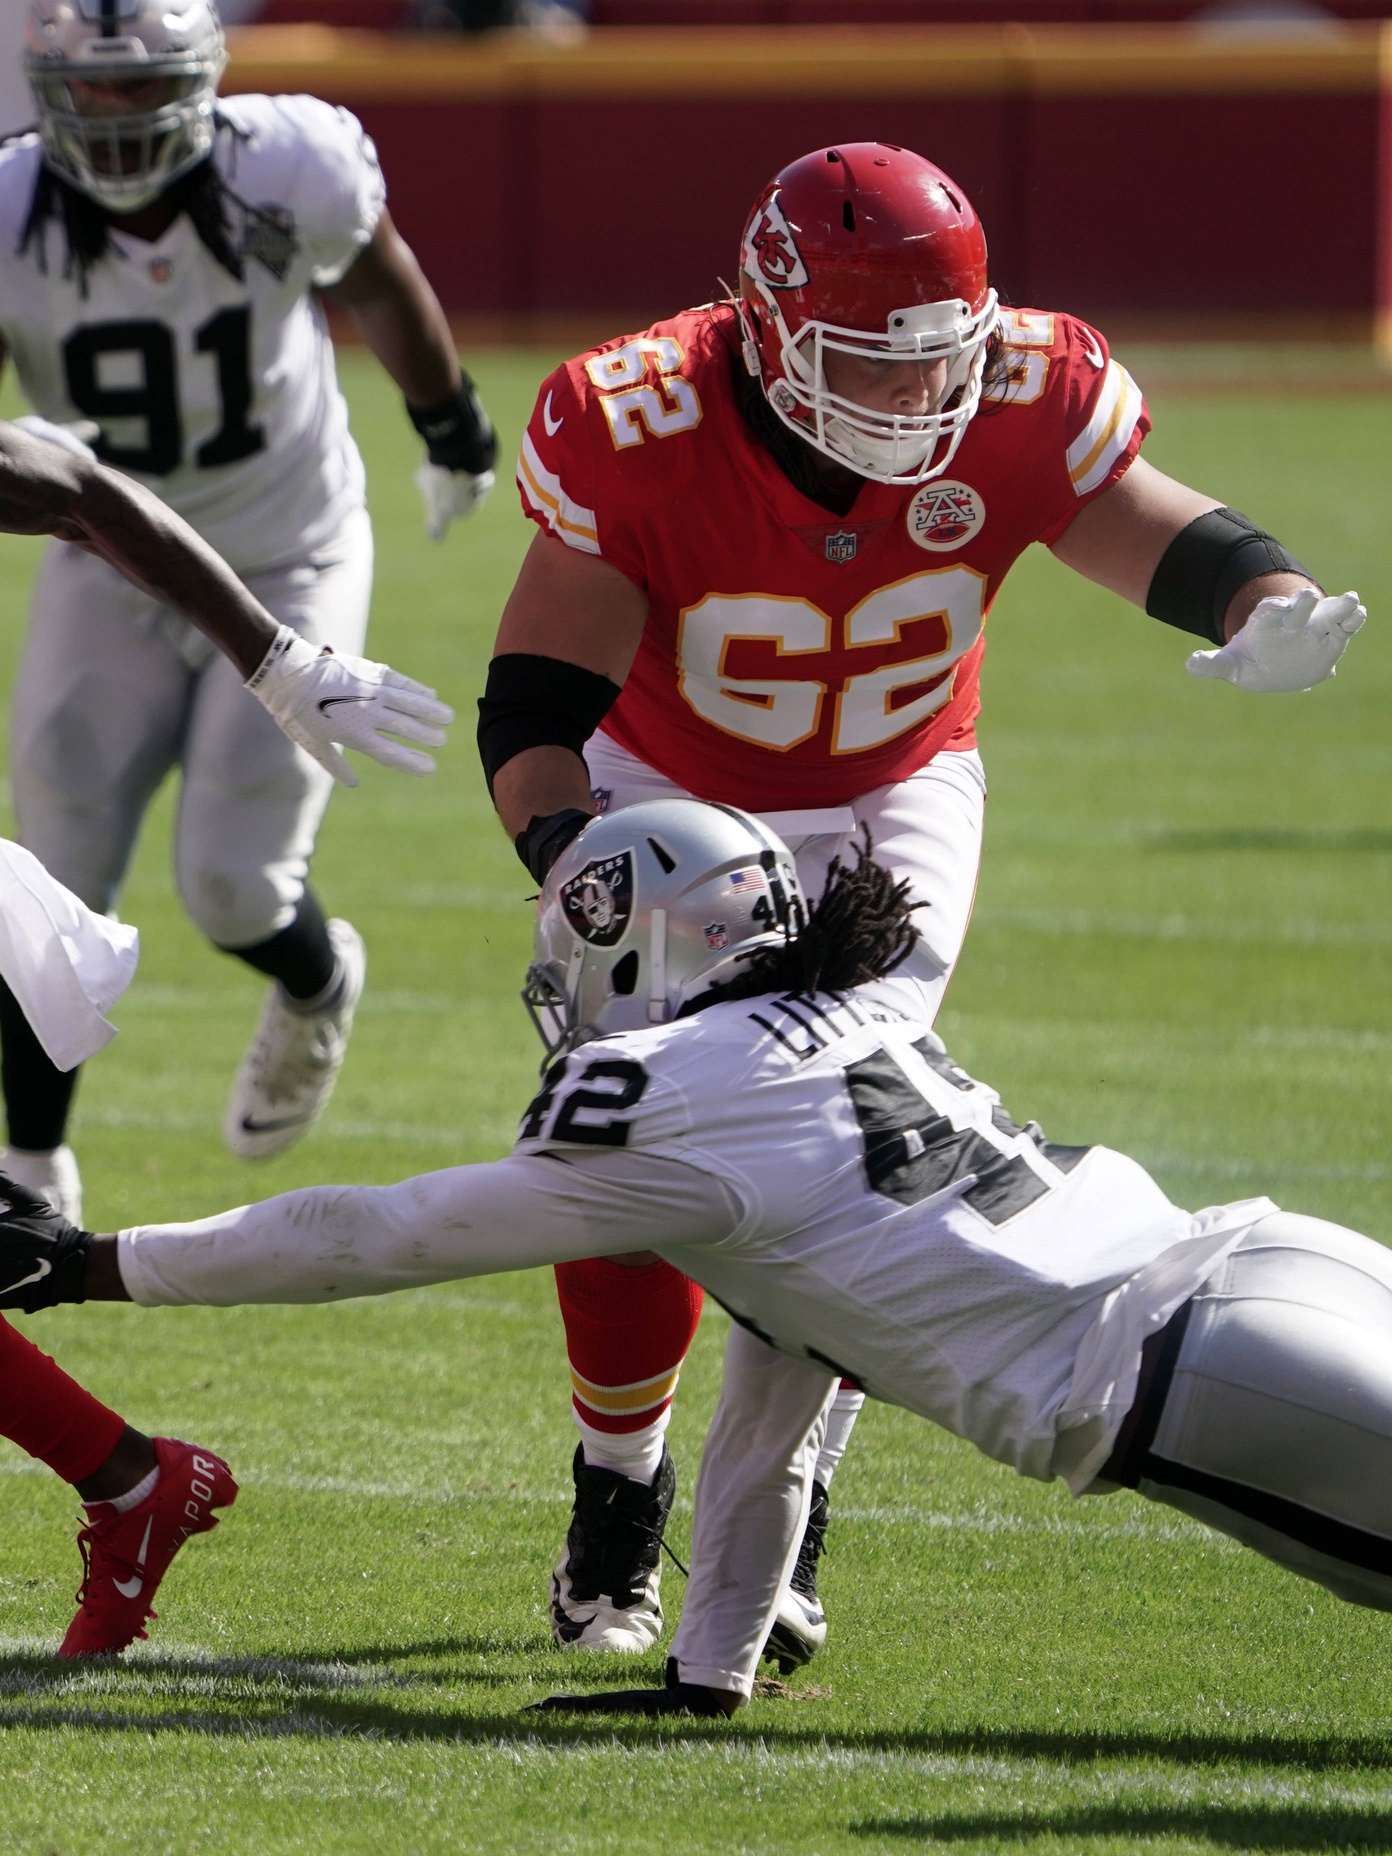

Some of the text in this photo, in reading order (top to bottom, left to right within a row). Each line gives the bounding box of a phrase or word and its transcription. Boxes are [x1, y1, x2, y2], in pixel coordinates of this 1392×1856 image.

[61, 303, 268, 478] 91
[584, 337, 704, 452] 62
[831, 546, 852, 558] NFL
[677, 563, 987, 756] 62
[565, 855, 625, 895] RAIDERS
